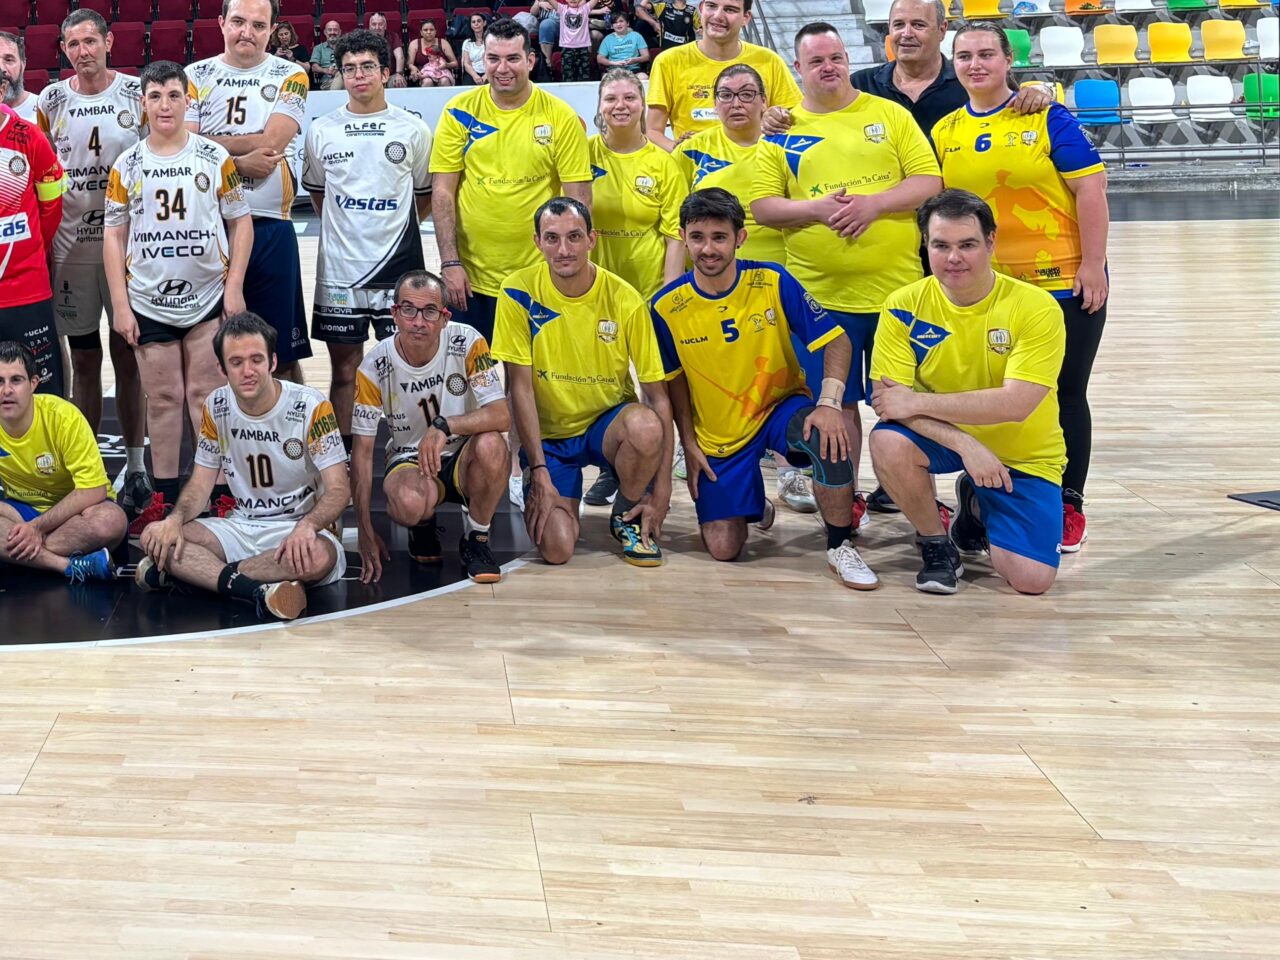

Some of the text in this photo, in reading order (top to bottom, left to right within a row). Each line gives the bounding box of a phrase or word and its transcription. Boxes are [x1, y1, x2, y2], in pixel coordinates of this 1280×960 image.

[76, 105, 114, 117] AMBAR
[226, 96, 247, 125] 15
[88, 126, 102, 157] 4
[975, 133, 991, 152] 6
[326, 152, 354, 161] UCLM
[65, 166, 111, 179] EIMAN
[152, 167, 193, 178] AMBAR
[71, 181, 110, 191] IVEC
[823, 179, 862, 190] Fundación
[155, 188, 187, 221] 34
[335, 195, 398, 211] Vestas
[76, 227, 103, 236] HYUN
[141, 245, 205, 259] IVECO
[320, 306, 352, 315] GIVOVA
[29, 326, 49, 337] UCLM
[721, 318, 740, 343] 5
[684, 336, 709, 345] UCLM
[410, 373, 444, 393] AMBA
[551, 371, 587, 383] Fundación
[353, 405, 380, 421] baco
[418, 393, 440, 427] 11
[239, 429, 281, 443] AMBAR
[246, 453, 274, 489] 10
